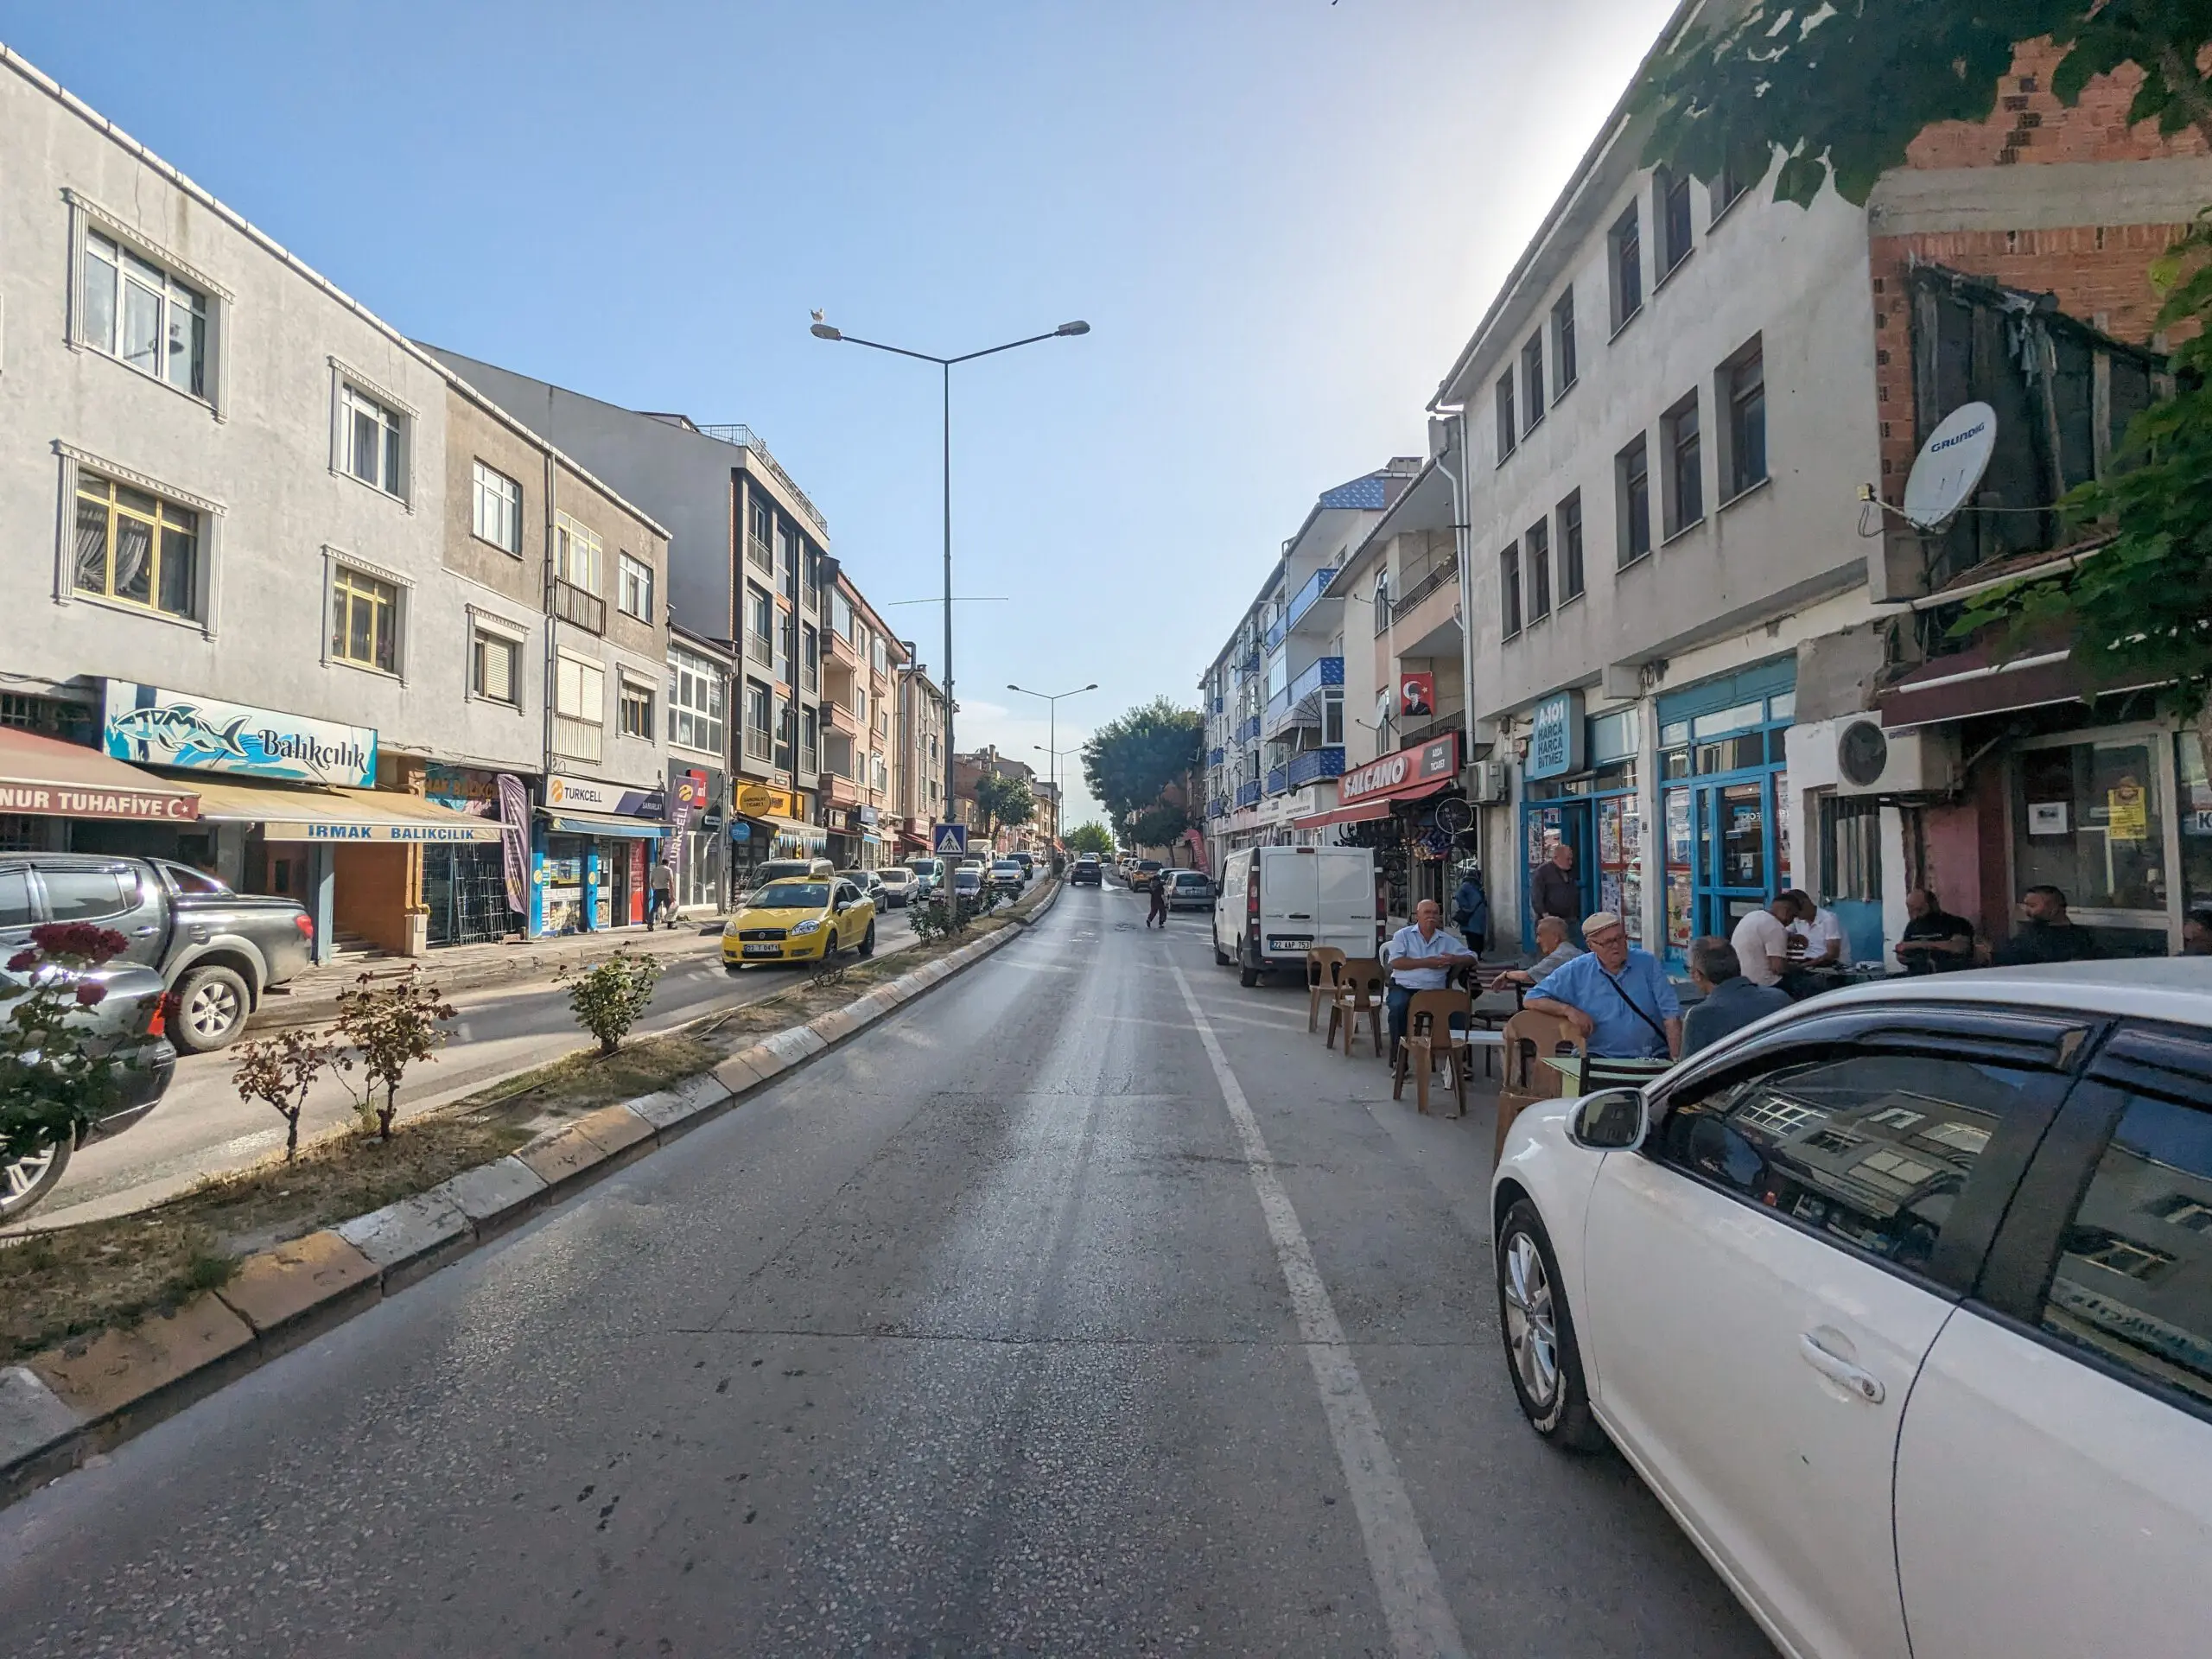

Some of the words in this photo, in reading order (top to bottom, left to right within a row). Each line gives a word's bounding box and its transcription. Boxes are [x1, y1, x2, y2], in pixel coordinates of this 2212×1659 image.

[1931, 422, 1985, 452] GRUNDIG
[1538, 721, 1563, 741] HARCA
[258, 729, 369, 774] Balıkçılık
[1538, 736, 1563, 755] HARCA
[1344, 757, 1405, 798] SALCANO
[58, 792, 162, 816] TUHAFİYE
[564, 786, 602, 803] TURKCELL
[308, 825, 372, 839] IRMAK
[391, 826, 474, 841] BALIKÇILIK
[668, 804, 689, 868] TURKCELL
